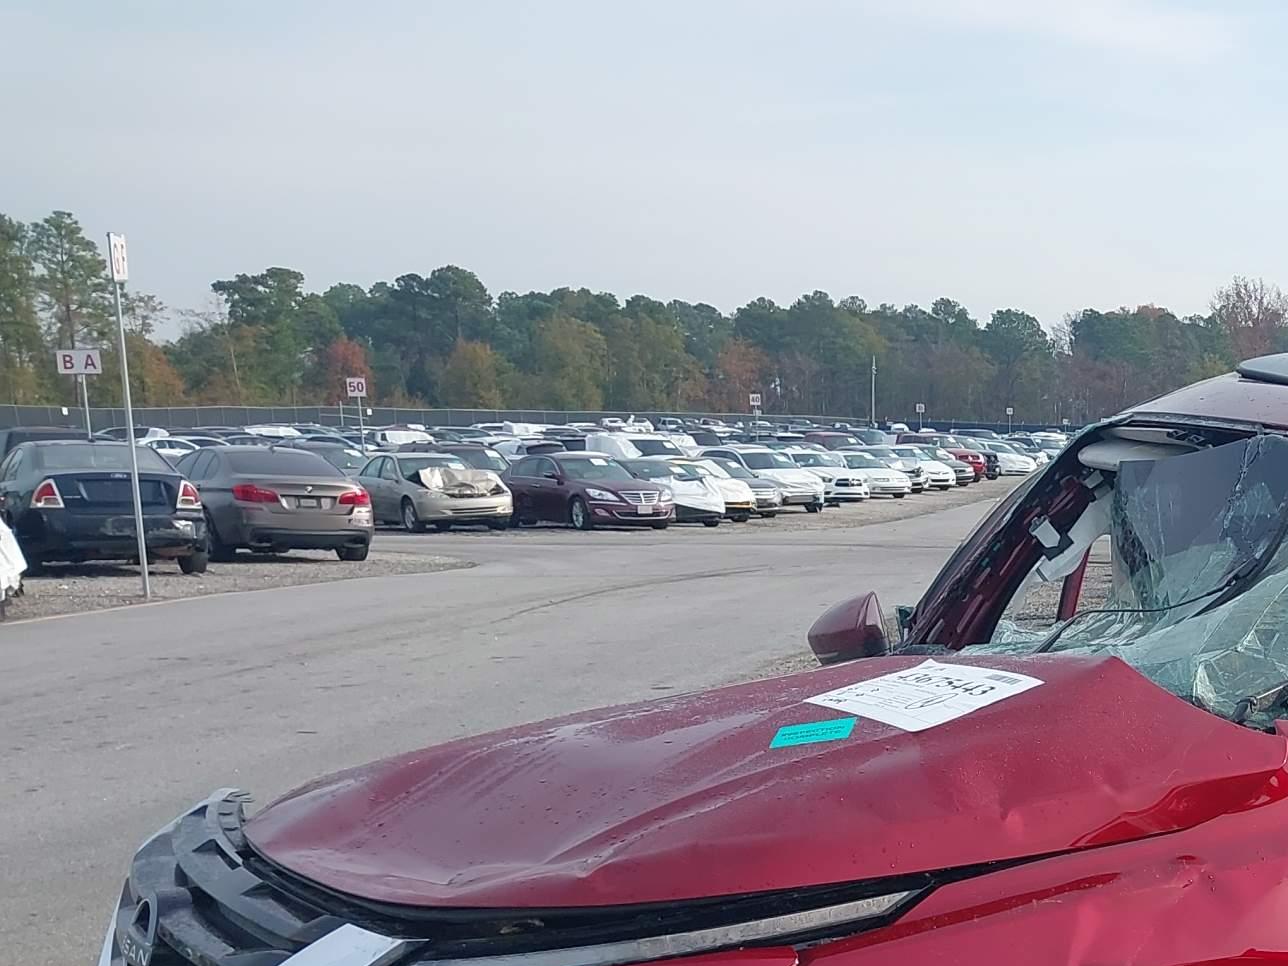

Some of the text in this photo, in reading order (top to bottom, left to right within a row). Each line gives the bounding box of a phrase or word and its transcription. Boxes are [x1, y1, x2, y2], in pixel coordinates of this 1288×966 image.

[62, 354, 97, 370] B A
[348, 381, 364, 393] 50
